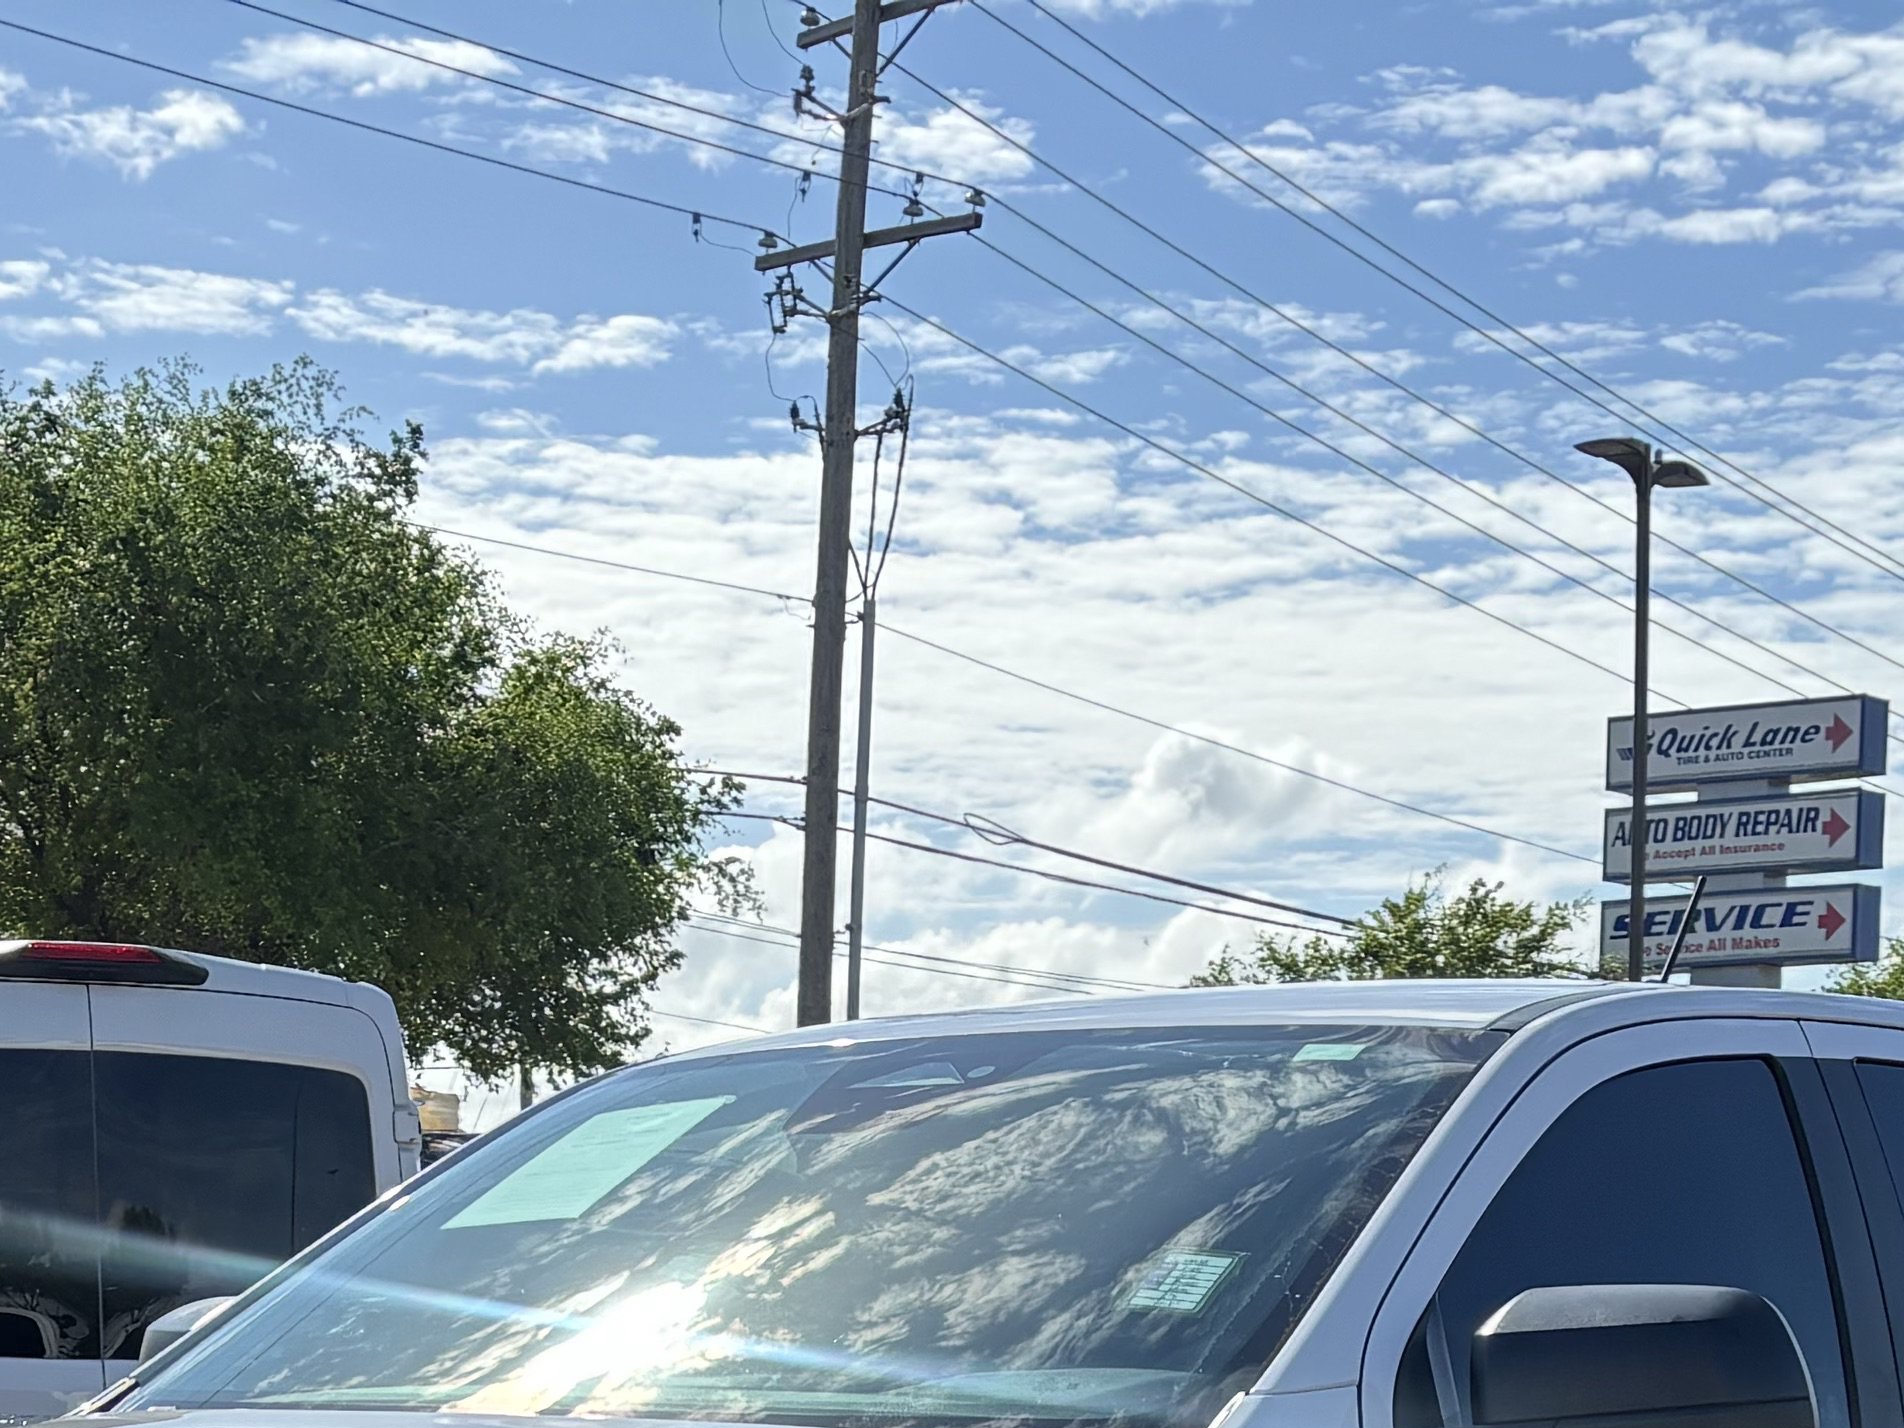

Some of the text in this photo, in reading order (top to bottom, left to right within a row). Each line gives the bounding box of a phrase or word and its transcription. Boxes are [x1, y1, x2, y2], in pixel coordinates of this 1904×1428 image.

[1656, 720, 1822, 757] Quick Lane
[1676, 747, 1793, 766] TIRE & AUTO CENTER
[1611, 806, 1820, 848] ATO BODY REPAIR
[1653, 847, 1695, 861] Accept
[1700, 844, 1716, 856] All
[1719, 841, 1785, 855] Insurance
[1609, 901, 1814, 939] SERVICE
[1656, 939, 1703, 957] Seice
[1706, 937, 1726, 952] All
[1731, 936, 1780, 951] Makes
